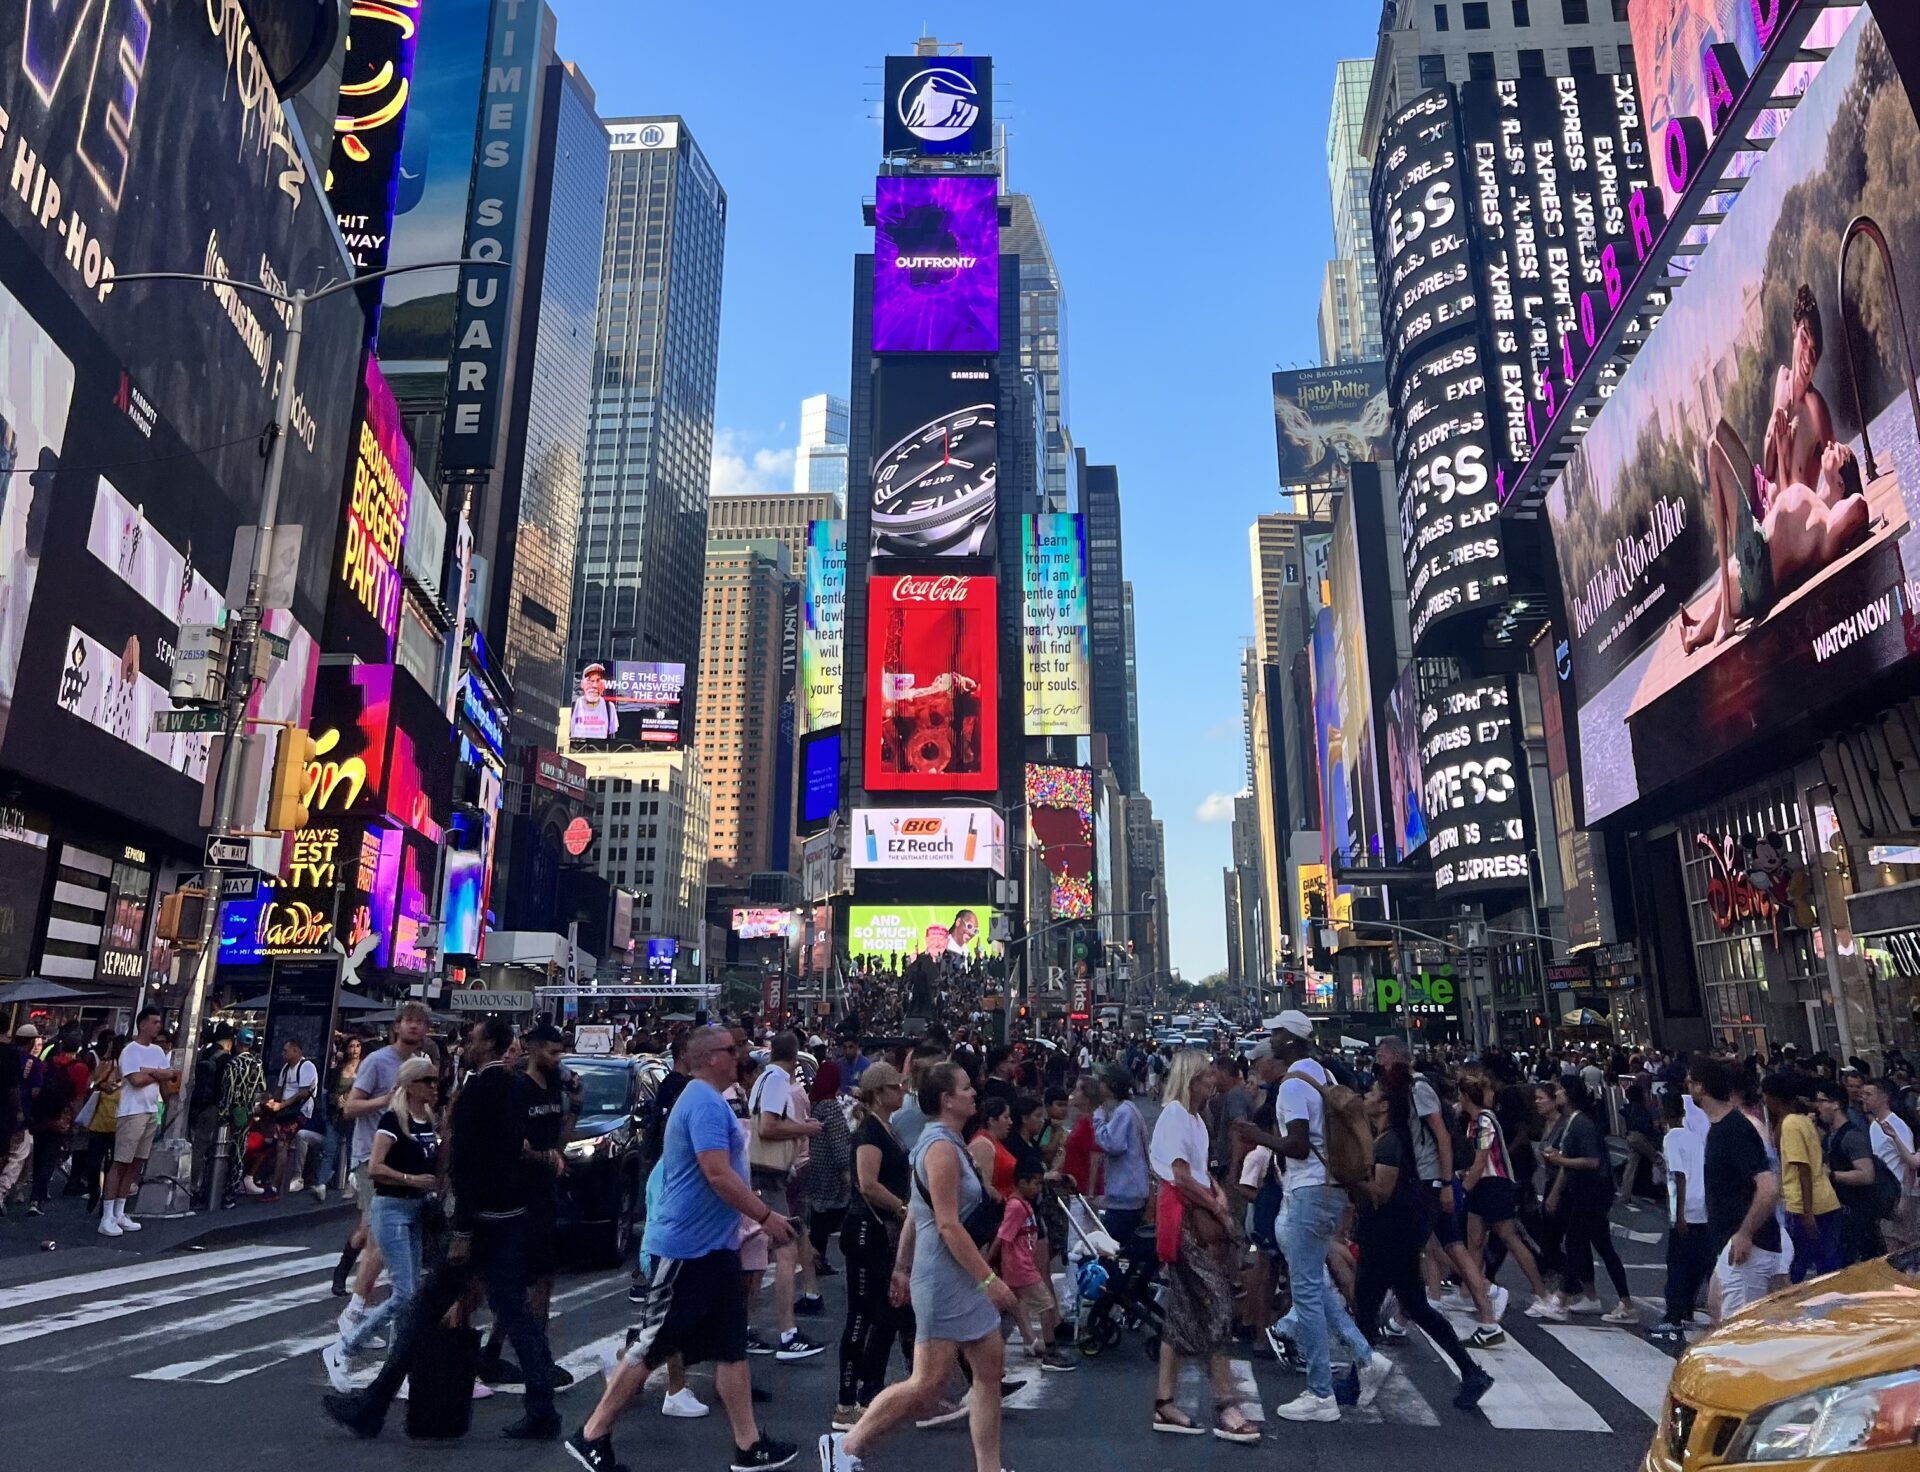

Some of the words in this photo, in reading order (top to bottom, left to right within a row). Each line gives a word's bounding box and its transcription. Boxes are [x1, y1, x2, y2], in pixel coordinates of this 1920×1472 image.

[483, 0, 528, 168] TIMES
[1556, 77, 1588, 172] EXPRESS
[337, 215, 368, 228] HIT
[455, 199, 504, 434] SQUARE
[951, 371, 989, 380] SAMSUNG
[1299, 372, 1313, 381] ON
[1316, 368, 1365, 379] BROADWAY
[1296, 385, 1332, 409] Harry
[1332, 380, 1370, 404] Potter
[131, 387, 157, 424] MARRIOTT
[272, 360, 316, 453] pdora
[128, 404, 152, 438] MARQUIS
[360, 420, 409, 521] BROADWAY'S
[352, 457, 405, 570] BIGGEST
[1615, 539, 1634, 597] &
[1655, 494, 1686, 552] Blue
[822, 556, 846, 569] from
[1026, 552, 1051, 564] from
[1054, 555, 1070, 564] me
[343, 514, 400, 636] PARTY!
[822, 574, 838, 586] for
[1027, 570, 1042, 582] for
[1052, 573, 1069, 582] am
[1057, 587, 1077, 599] and
[821, 609, 845, 622] lowl
[1027, 605, 1056, 620] lowly
[1059, 605, 1071, 618] of
[1057, 626, 1076, 641] you
[1812, 616, 1858, 663] WATCH
[1856, 593, 1891, 638] NOW
[819, 645, 839, 658] will
[1027, 642, 1047, 654] will
[1050, 641, 1071, 654] find
[821, 663, 841, 677] rest
[1029, 661, 1052, 673] rest
[1054, 660, 1070, 672] for
[621, 672, 635, 681] BE
[638, 673, 657, 682] THE
[660, 674, 681, 683] ONE
[604, 681, 629, 690] WHO
[631, 682, 681, 692] ANSWERS
[1047, 678, 1080, 691] souls.
[634, 691, 653, 700] THE
[656, 692, 680, 701] CALL
[810, 684, 834, 699] your
[1053, 704, 1083, 716] Christ
[171, 714, 184, 730] W
[190, 713, 207, 730] 45
[888, 840, 905, 852] EZ
[908, 837, 953, 852] Reach
[213, 846, 225, 858] ONE
[231, 847, 244, 859] WAY
[223, 879, 248, 892] WAY
[870, 915, 900, 926] AND
[854, 927, 875, 938] SO
[877, 927, 917, 938] MUCH
[862, 939, 907, 951] MORE!
[101, 950, 142, 978] SEPHORA
[452, 994, 523, 1007] SWAROVSKI
[1395, 1004, 1445, 1013] SCCER
